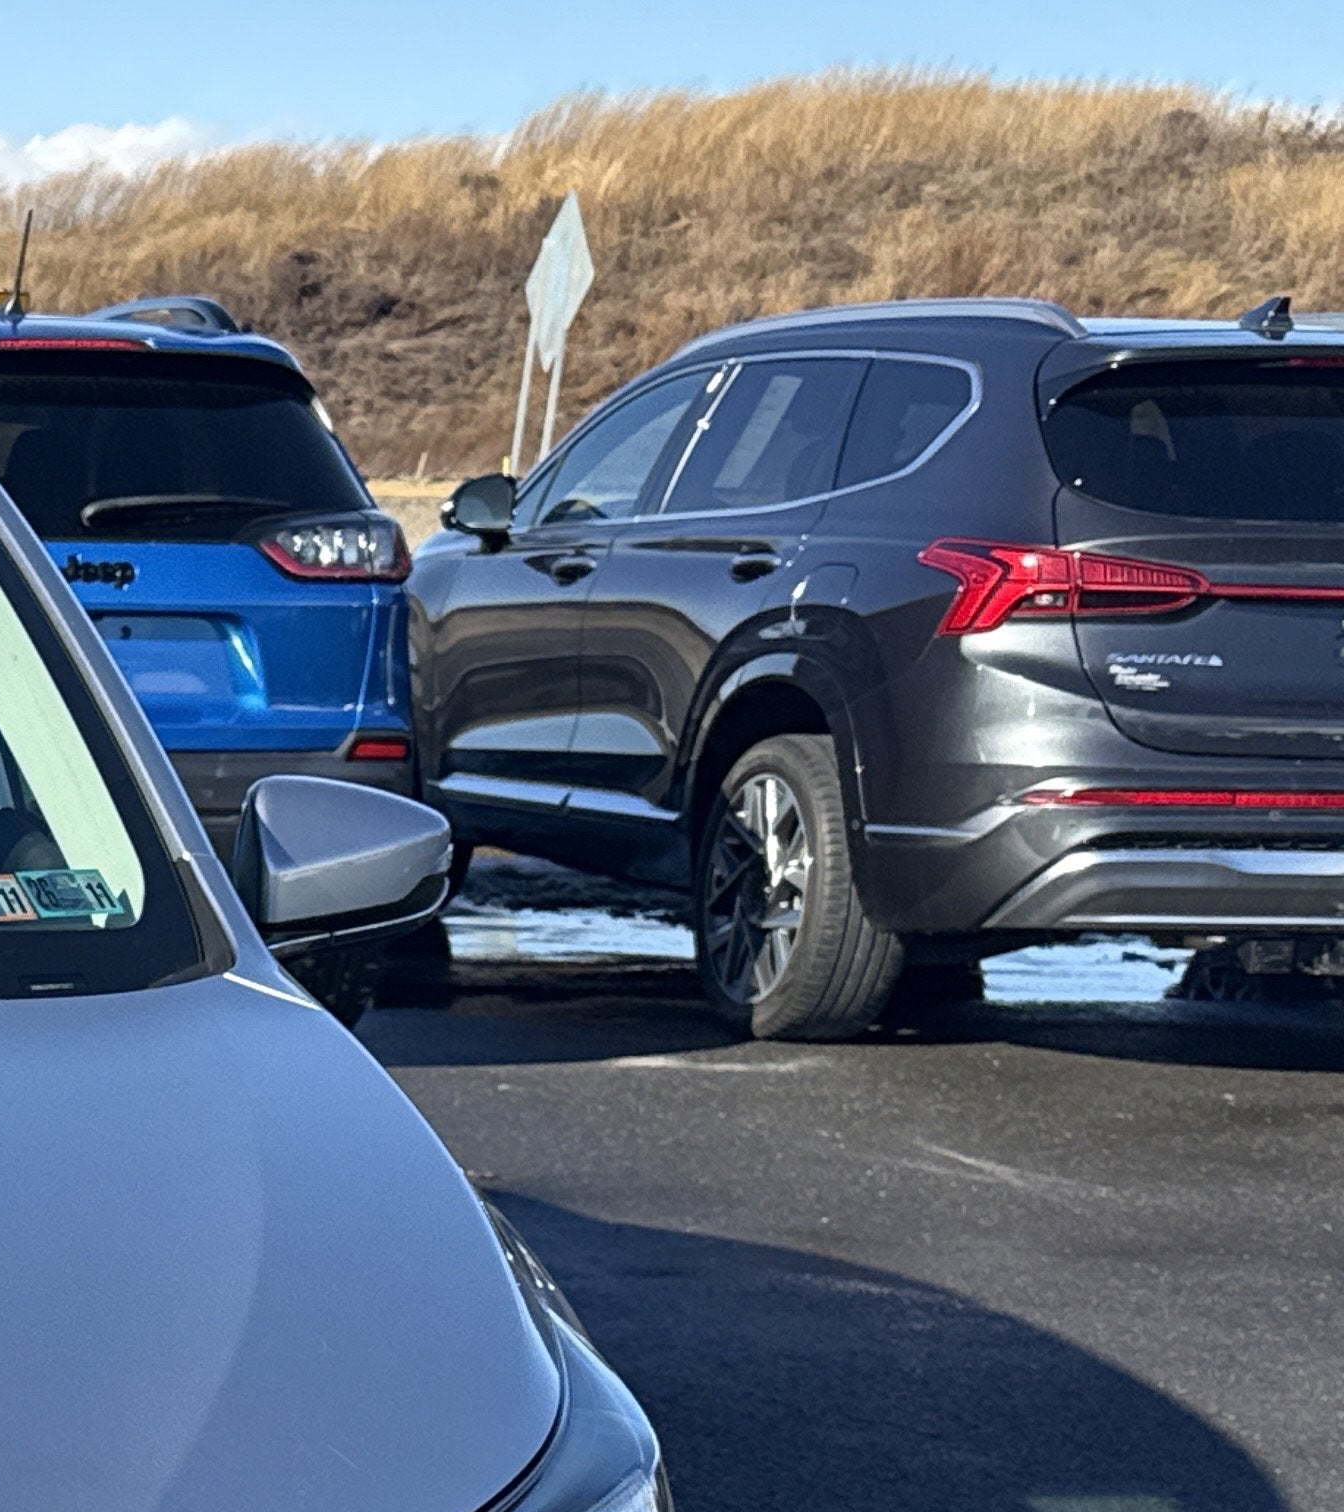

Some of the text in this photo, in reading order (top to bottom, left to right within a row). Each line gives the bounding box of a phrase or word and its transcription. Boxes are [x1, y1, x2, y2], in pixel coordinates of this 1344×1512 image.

[59, 554, 136, 590] Jeep
[26, 875, 117, 910] 26 11
